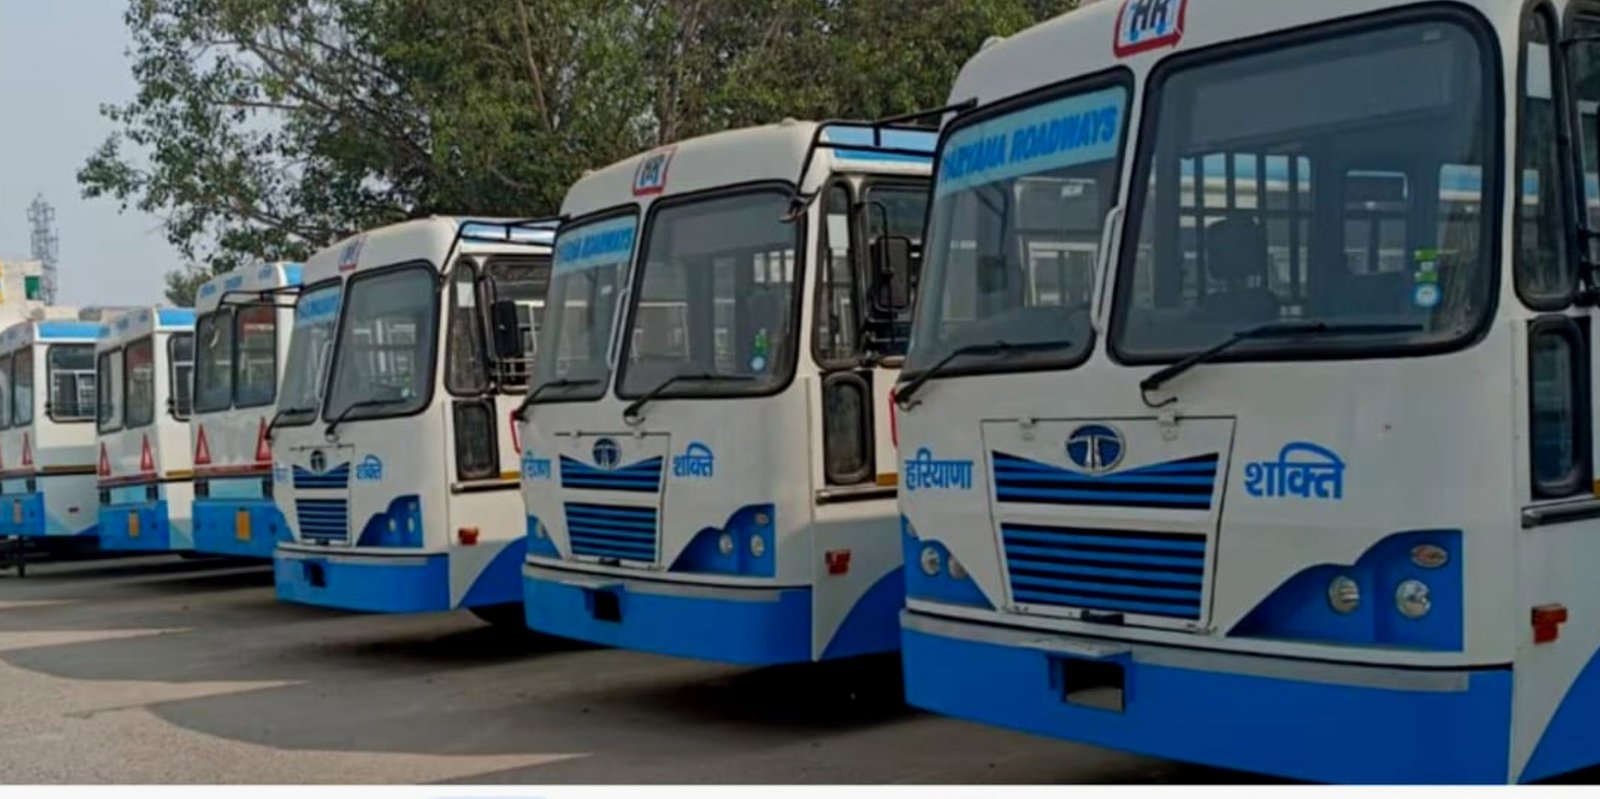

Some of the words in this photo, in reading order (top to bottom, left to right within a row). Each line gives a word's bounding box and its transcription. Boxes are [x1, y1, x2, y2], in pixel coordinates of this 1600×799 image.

[1009, 105, 1119, 164] ROADWAYS
[673, 441, 714, 478] शक्ति
[904, 447, 974, 490] हरियाणा
[1244, 441, 1346, 500] शक्ति
